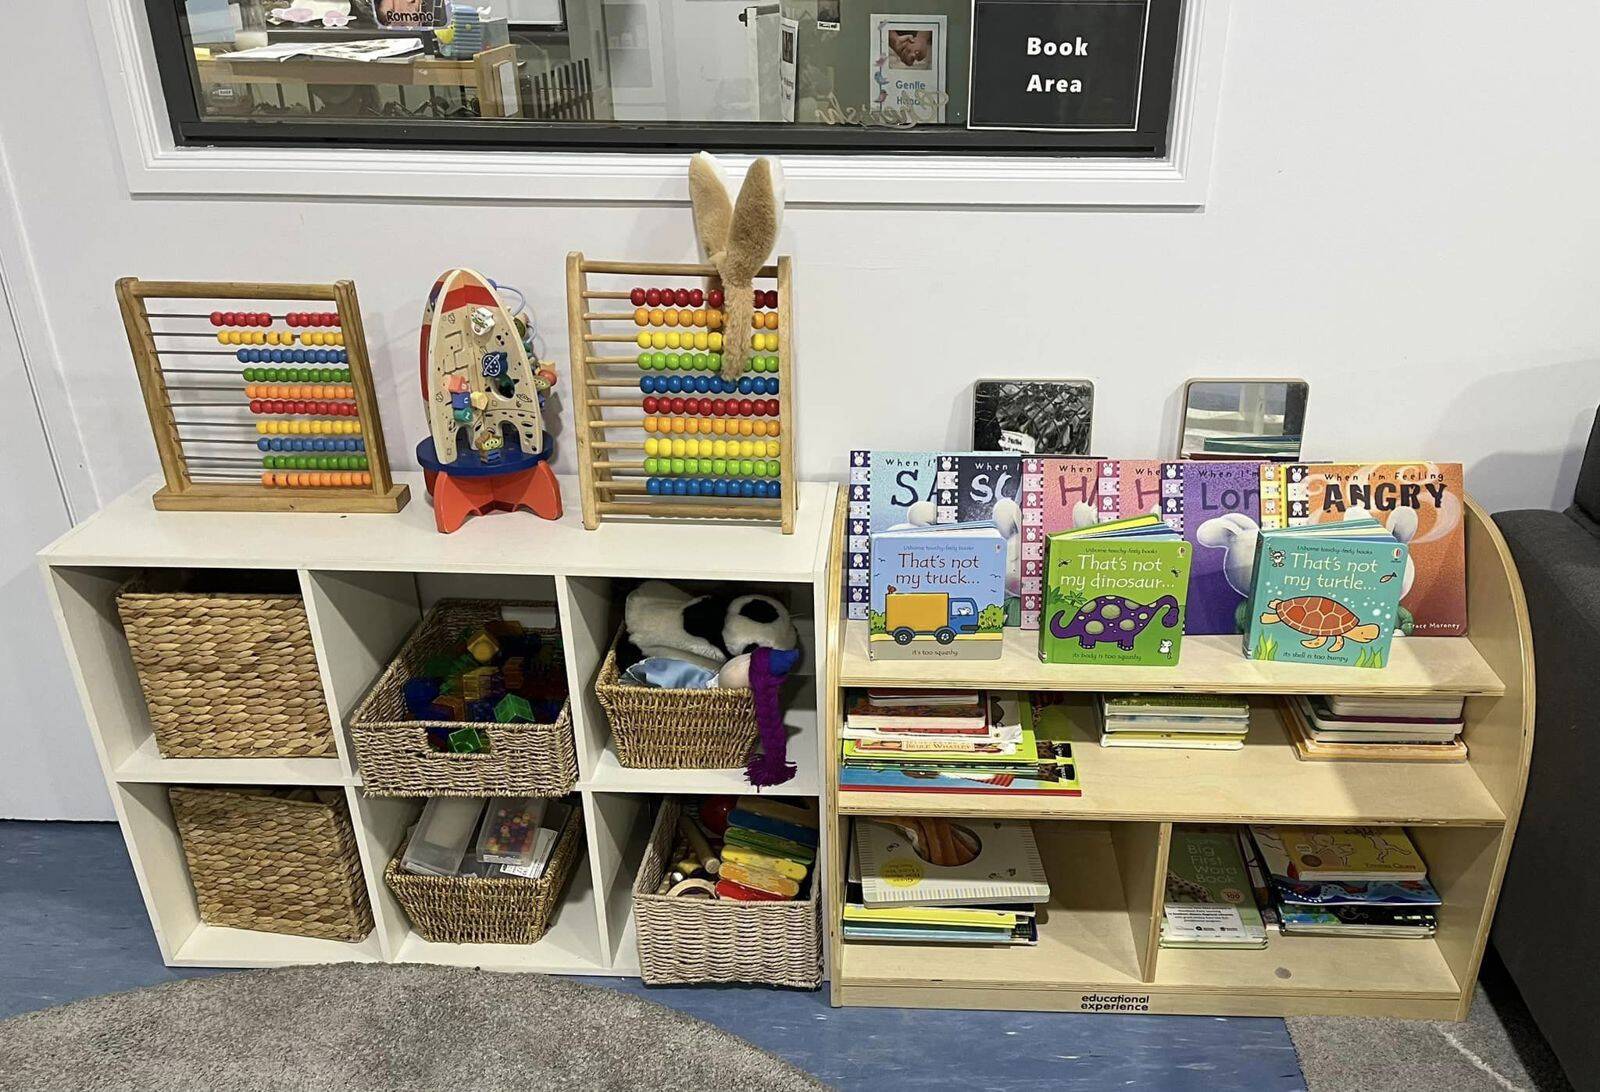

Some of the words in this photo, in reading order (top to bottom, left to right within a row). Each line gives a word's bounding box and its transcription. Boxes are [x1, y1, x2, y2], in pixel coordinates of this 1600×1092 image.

[386, 10, 434, 22] Romano
[1027, 36, 1088, 56] Book
[1026, 74, 1082, 93] Area
[885, 459, 918, 467] When
[974, 462, 1008, 471] When
[1059, 465, 1092, 473] When
[1199, 470, 1232, 478] When
[1324, 473, 1358, 481] When
[1368, 472, 1386, 480] I'm
[1394, 471, 1444, 482] Feeling
[1323, 483, 1447, 513] ANGRY
[898, 552, 946, 569] That's
[951, 555, 980, 569] not
[1078, 553, 1127, 571] That's
[1133, 557, 1162, 572] not
[1290, 552, 1341, 571] That's
[1347, 559, 1379, 573] not
[896, 574, 920, 589] my
[926, 570, 980, 585] truck...
[1060, 575, 1086, 591] my
[1090, 572, 1175, 589] dinosaur...
[1284, 575, 1310, 591] my
[1316, 573, 1377, 590] turtle...
[1429, 622, 1460, 630] Moroney
[1081, 993, 1150, 1004] educational
[1080, 1002, 1149, 1012] experience
